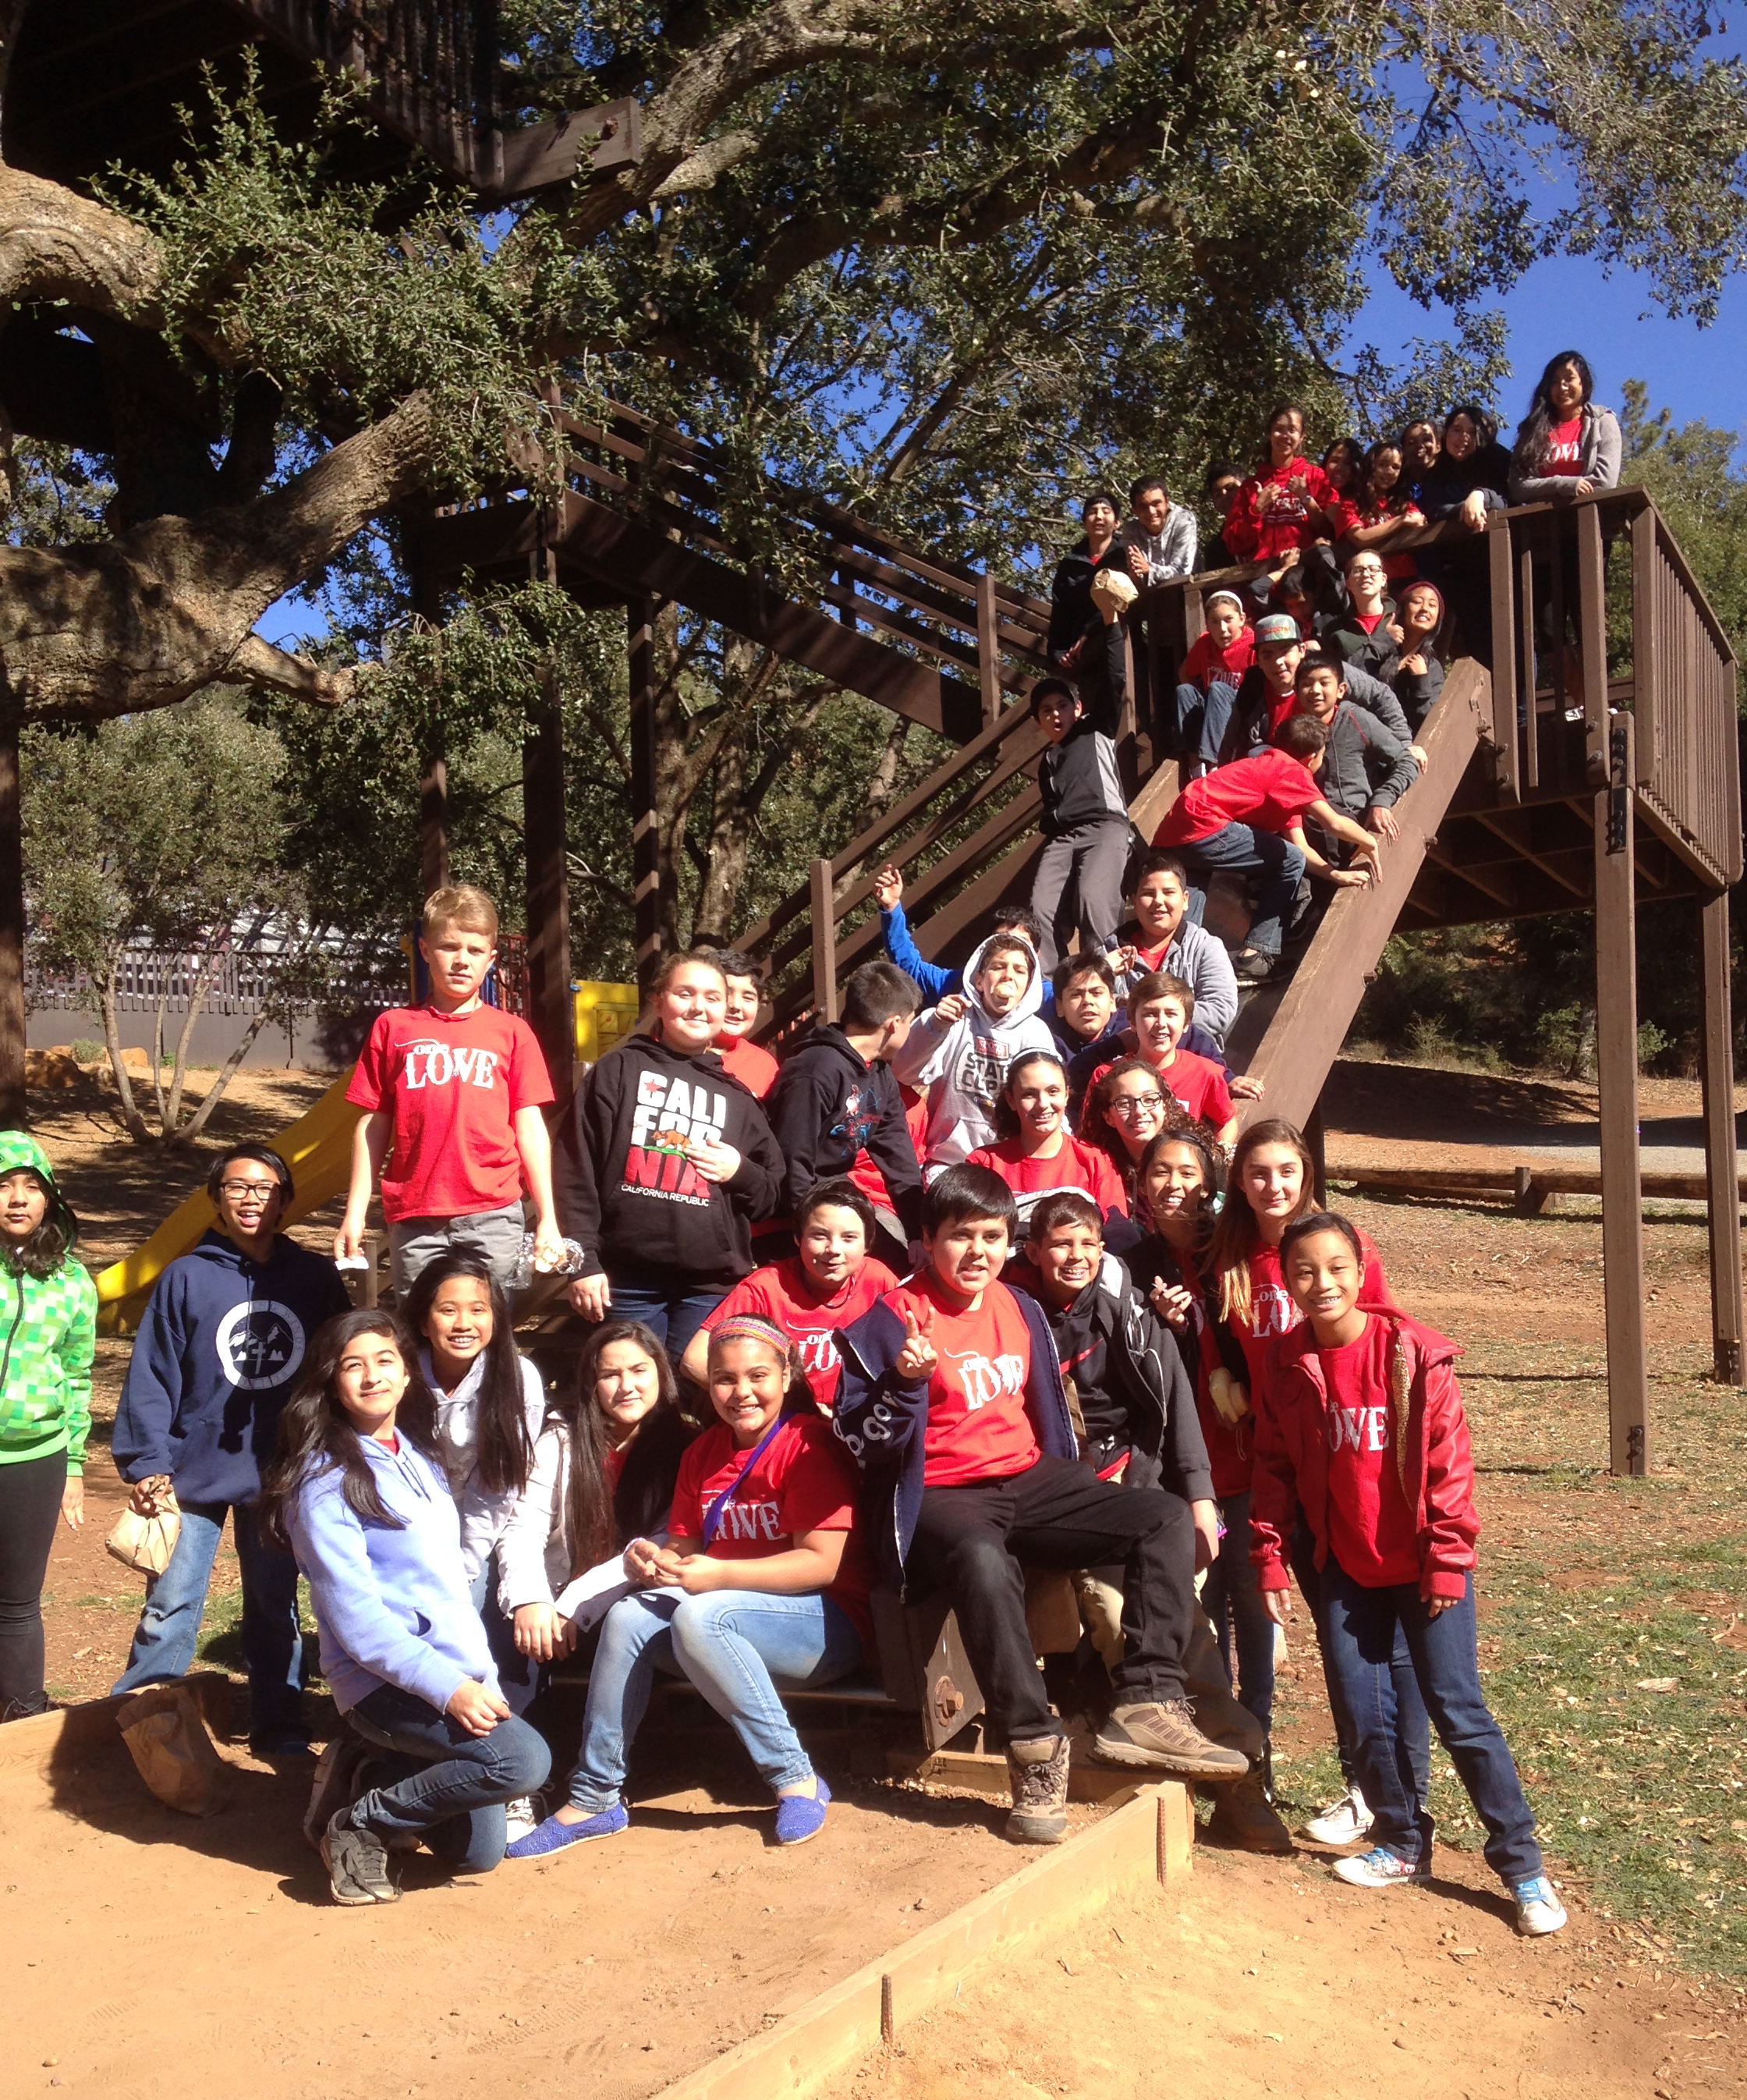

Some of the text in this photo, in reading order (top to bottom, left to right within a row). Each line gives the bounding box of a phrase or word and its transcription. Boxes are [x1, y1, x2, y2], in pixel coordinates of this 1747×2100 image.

[406, 1048, 498, 1090] LOVE
[637, 1070, 727, 1129] CALI
[621, 1183, 668, 1199] CALIFORNIA
[669, 1192, 710, 1207] REPUBLIC
[1328, 1407, 1389, 1452] OVE
